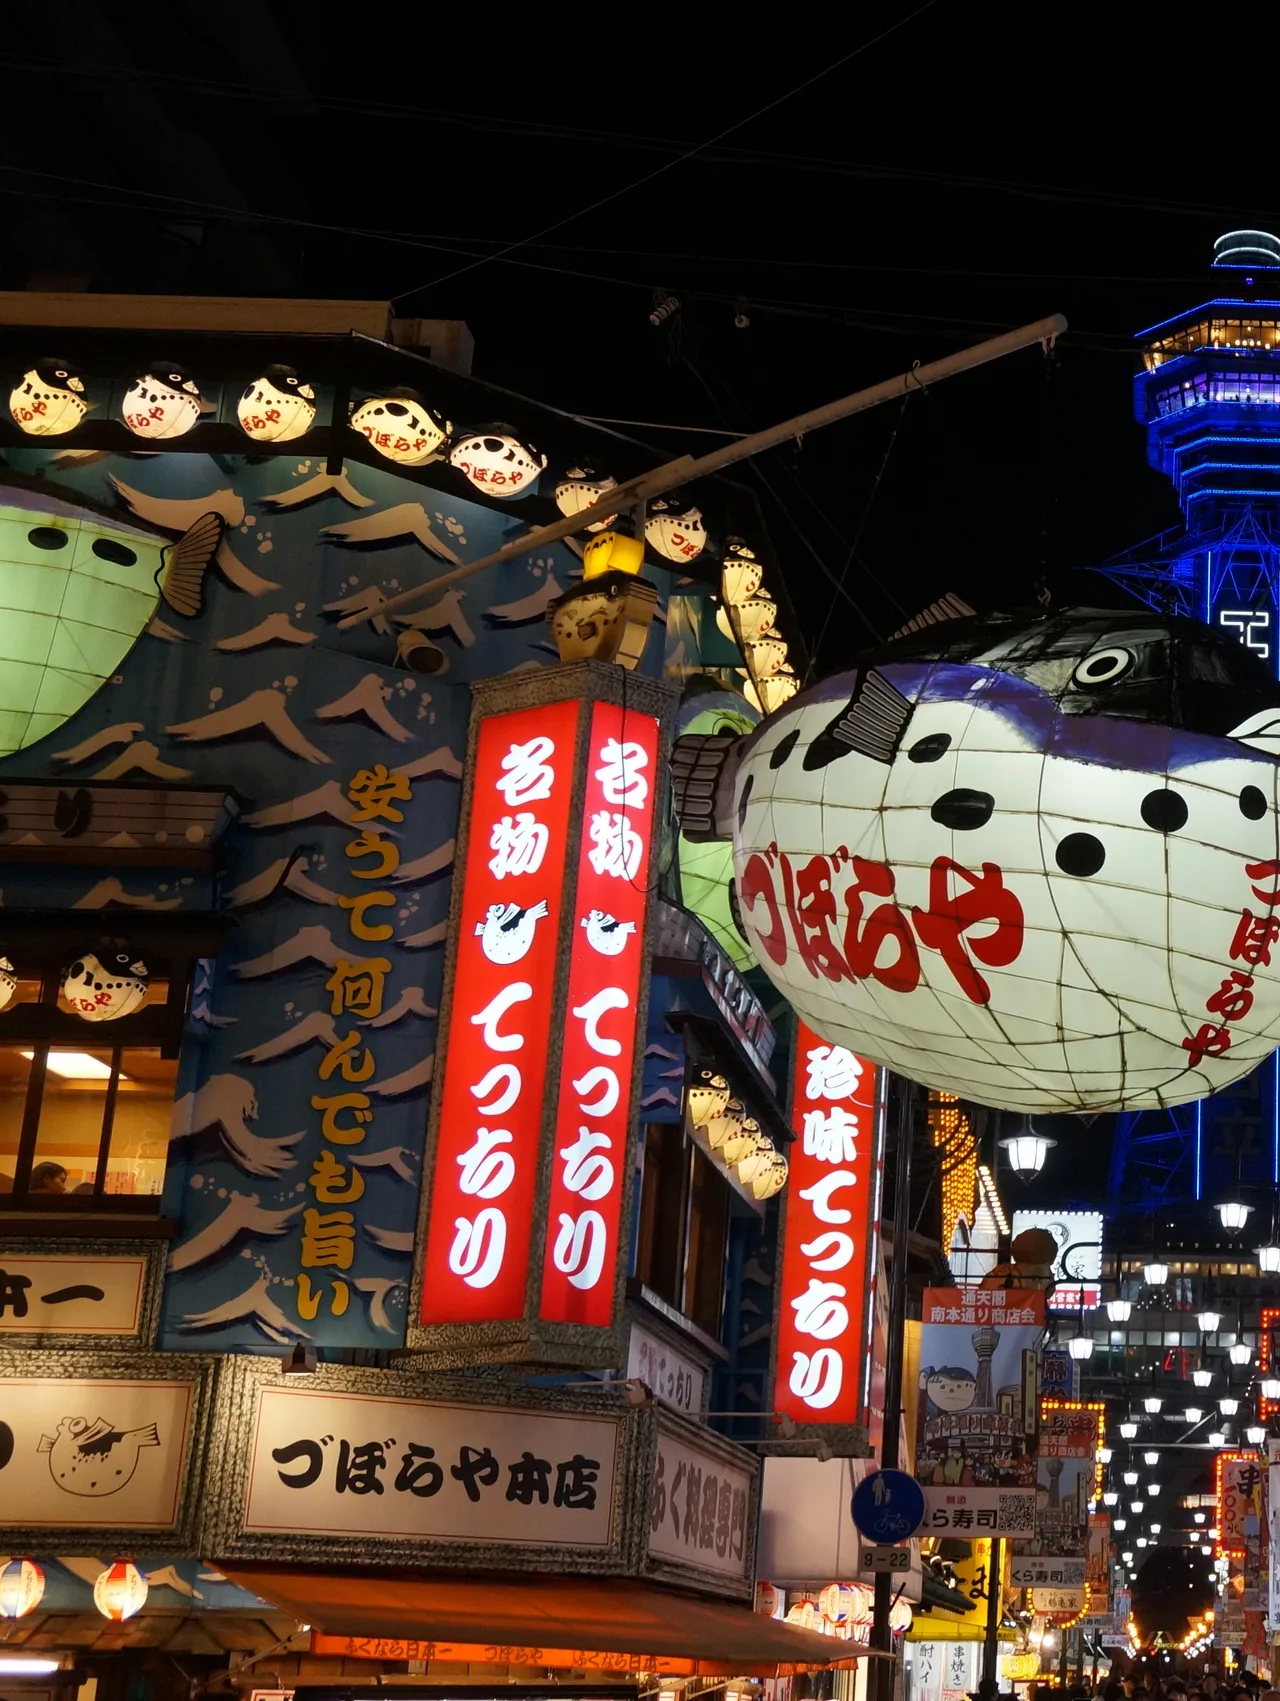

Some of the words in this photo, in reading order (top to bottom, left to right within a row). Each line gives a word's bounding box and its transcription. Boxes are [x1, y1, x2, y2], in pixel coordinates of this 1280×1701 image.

[488, 735, 555, 880] 名物
[587, 737, 649, 880] 名物
[741, 841, 1024, 1006] づぼらや
[297, 763, 412, 1321] 安うて何んでも旨い
[448, 981, 533, 1289] てっちり
[552, 986, 630, 1290] てっちり
[788, 1044, 864, 1409] 珍味てっちり
[930, 1306, 1036, 1324] 南本通り商店会
[961, 1290, 1006, 1306] 通天閣
[272, 1434, 601, 1511] づぼらや本店
[649, 1450, 746, 1563] ふぐ料理専門
[1011, 1570, 1063, 1583] くら寿司
[918, 1644, 934, 1683] 酎ハイ
[951, 1645, 966, 1686] 串焼き
